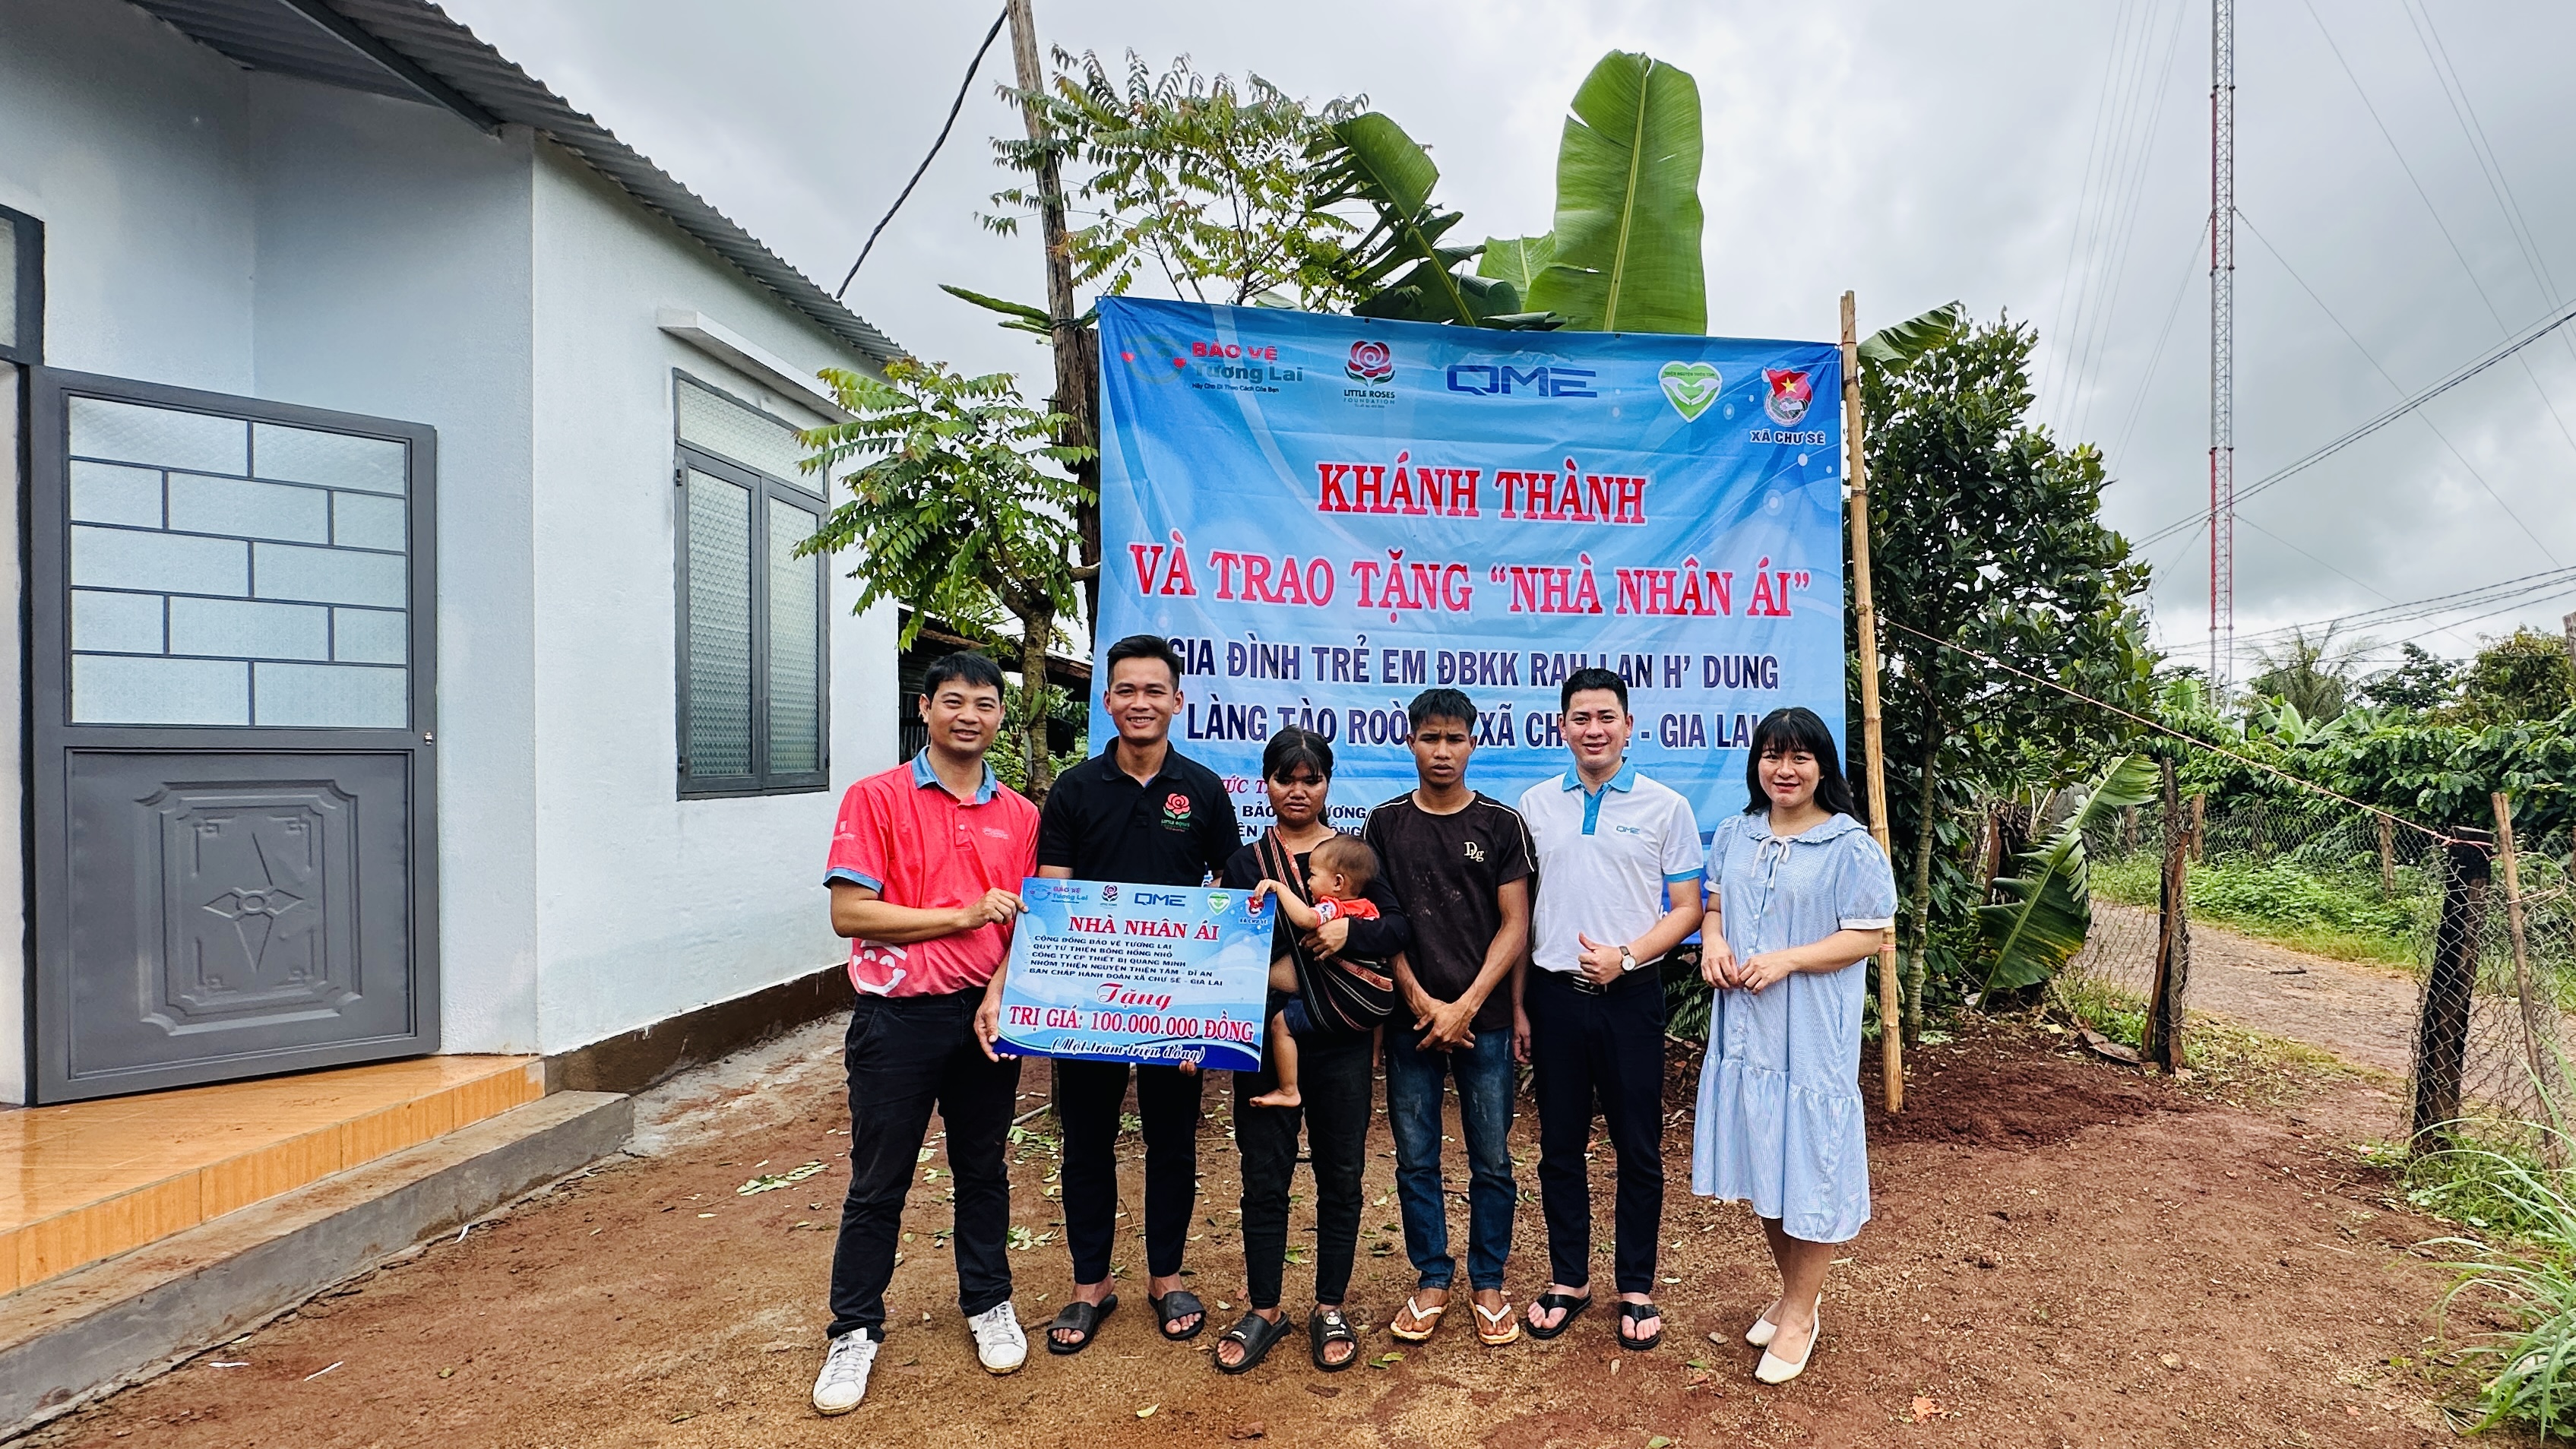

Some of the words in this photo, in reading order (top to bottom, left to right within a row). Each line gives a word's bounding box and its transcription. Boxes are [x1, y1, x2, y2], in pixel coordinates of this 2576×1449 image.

[1191, 339, 1242, 359] BẢO
[1247, 345, 1278, 365] VỆ
[1193, 363, 1263, 384] Tương
[1269, 366, 1304, 382] Lai
[1446, 364, 1598, 399] QME
[1343, 389, 1367, 397] LITTLE
[1369, 391, 1396, 399] ROSES
[1751, 429, 1771, 442] XÃ
[1774, 430, 1803, 444] CHƯ
[1807, 431, 1825, 444] SÊ
[1318, 451, 1480, 517] KHÁNH
[1495, 458, 1647, 524] THÀNH
[1130, 530, 1198, 596] VÀ
[1210, 550, 1335, 607] TRAO
[1351, 549, 1473, 624] TẶNG
[1491, 553, 1603, 614] “NHÀ
[1615, 557, 1733, 616] NHÂN
[1747, 556, 1811, 616] ÁI”
[1226, 633, 1300, 680] ĐÌNH
[1312, 634, 1370, 683] TRẺ
[1383, 649, 1426, 685] EM
[1437, 651, 1520, 686] ĐBKK
[1703, 654, 1779, 690] DUNG
[1187, 693, 1267, 742] LÀNG
[1277, 698, 1337, 744] TÀO
[1477, 703, 1515, 747] XÃ
[1660, 713, 1707, 748] GIA
[1616, 825, 1641, 835] QME
[1135, 892, 1187, 907] QME
[1068, 914, 1117, 934] NHÀ
[1123, 918, 1188, 938] NHÂN
[1194, 920, 1220, 941] ÁI
[1097, 982, 1172, 1011] Tặng
[1009, 1005, 1041, 1032] TRỊ
[1046, 1004, 1084, 1030] GIÁ:
[1090, 1011, 1199, 1038] 100.000.000
[1204, 1010, 1255, 1041] ĐỒNG
